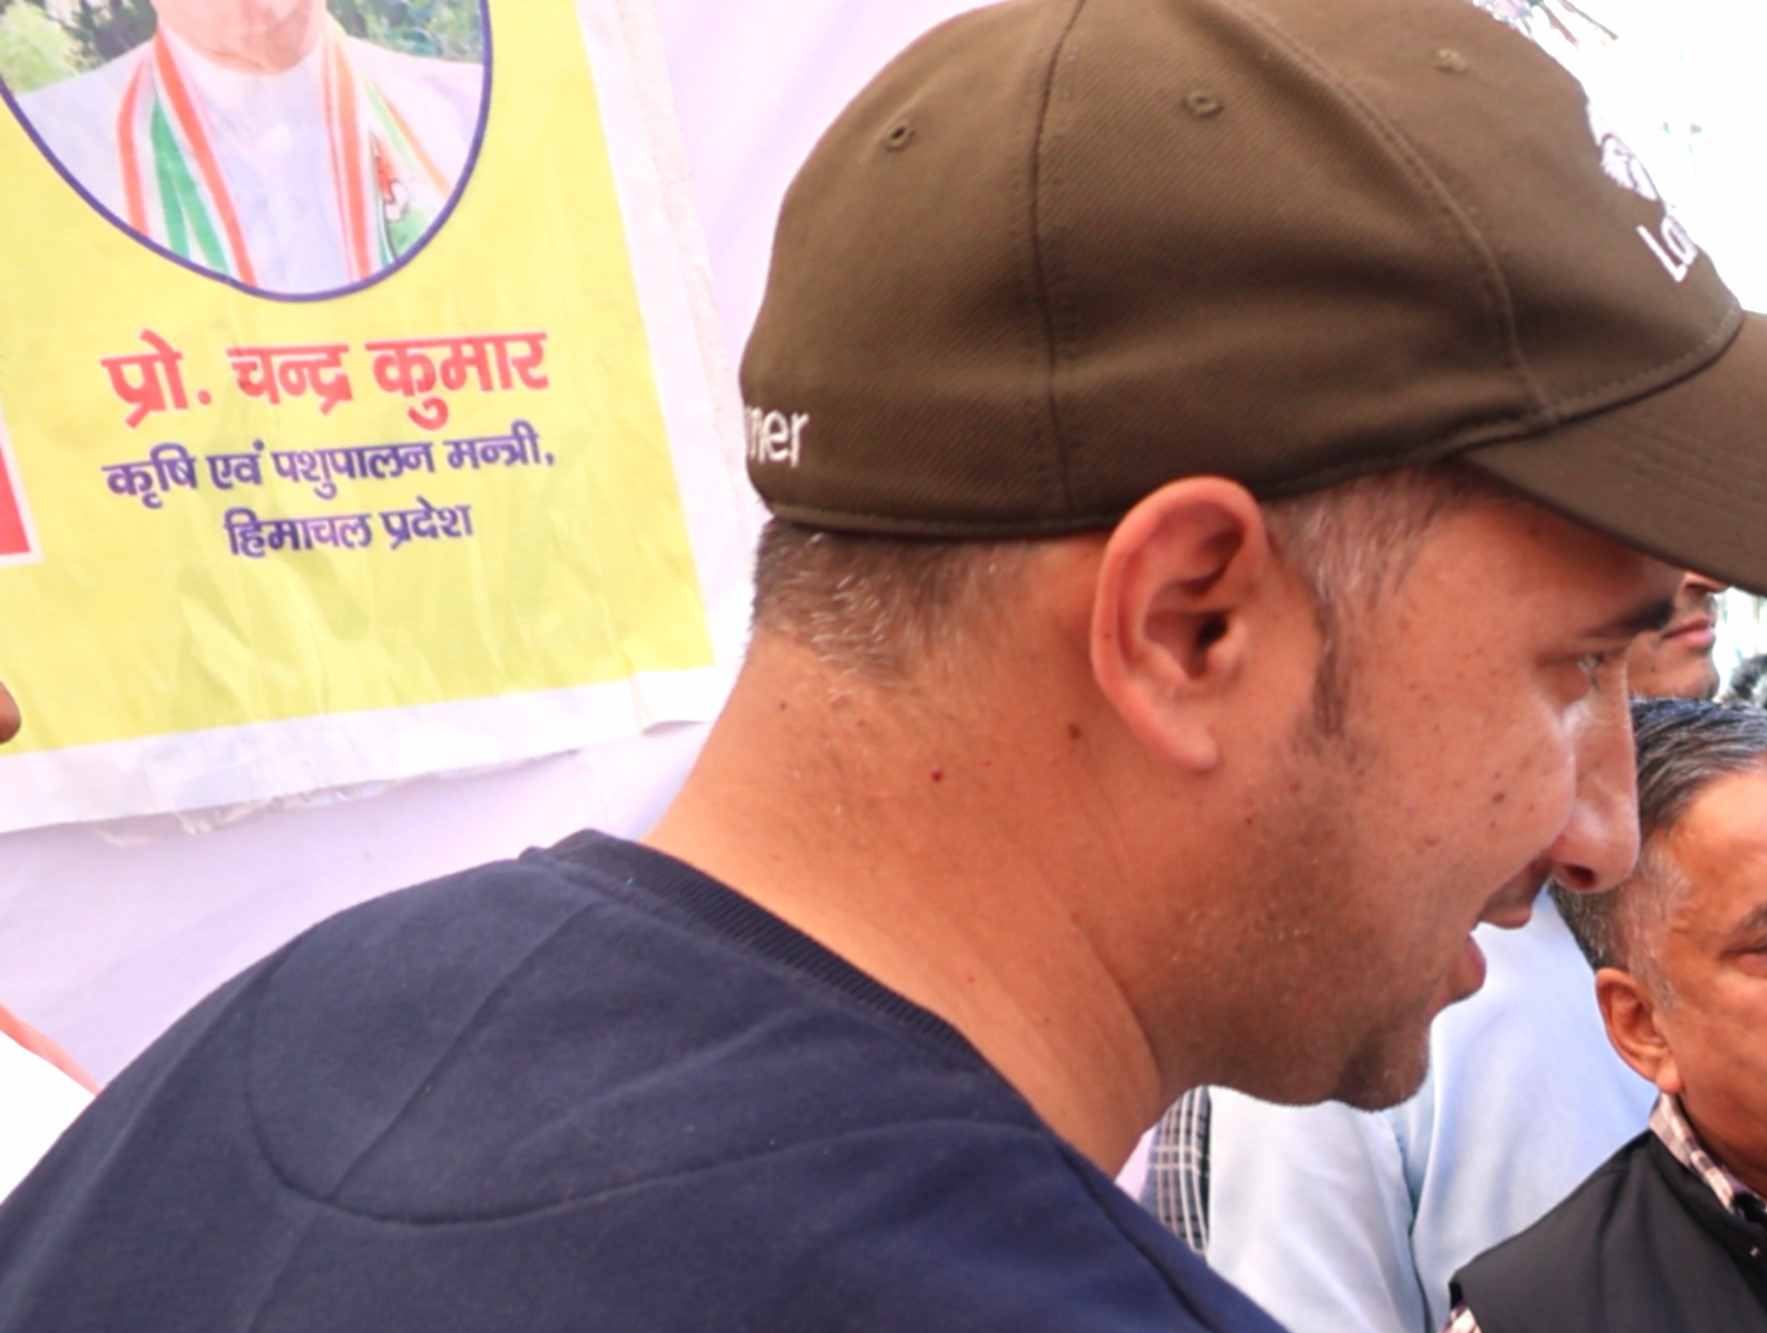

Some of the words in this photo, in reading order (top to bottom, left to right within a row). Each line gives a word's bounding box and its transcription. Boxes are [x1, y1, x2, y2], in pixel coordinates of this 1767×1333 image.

[101, 328, 212, 429] प्रो.
[227, 344, 354, 415] चन्द्र
[365, 332, 549, 430] कुमार
[101, 442, 198, 510] कृषि
[206, 439, 264, 490] एवं
[271, 441, 436, 500] पशुपालन
[443, 419, 556, 471] मन्त्री,
[224, 507, 373, 558] हिमाचल
[379, 496, 473, 550] प्रदेश
